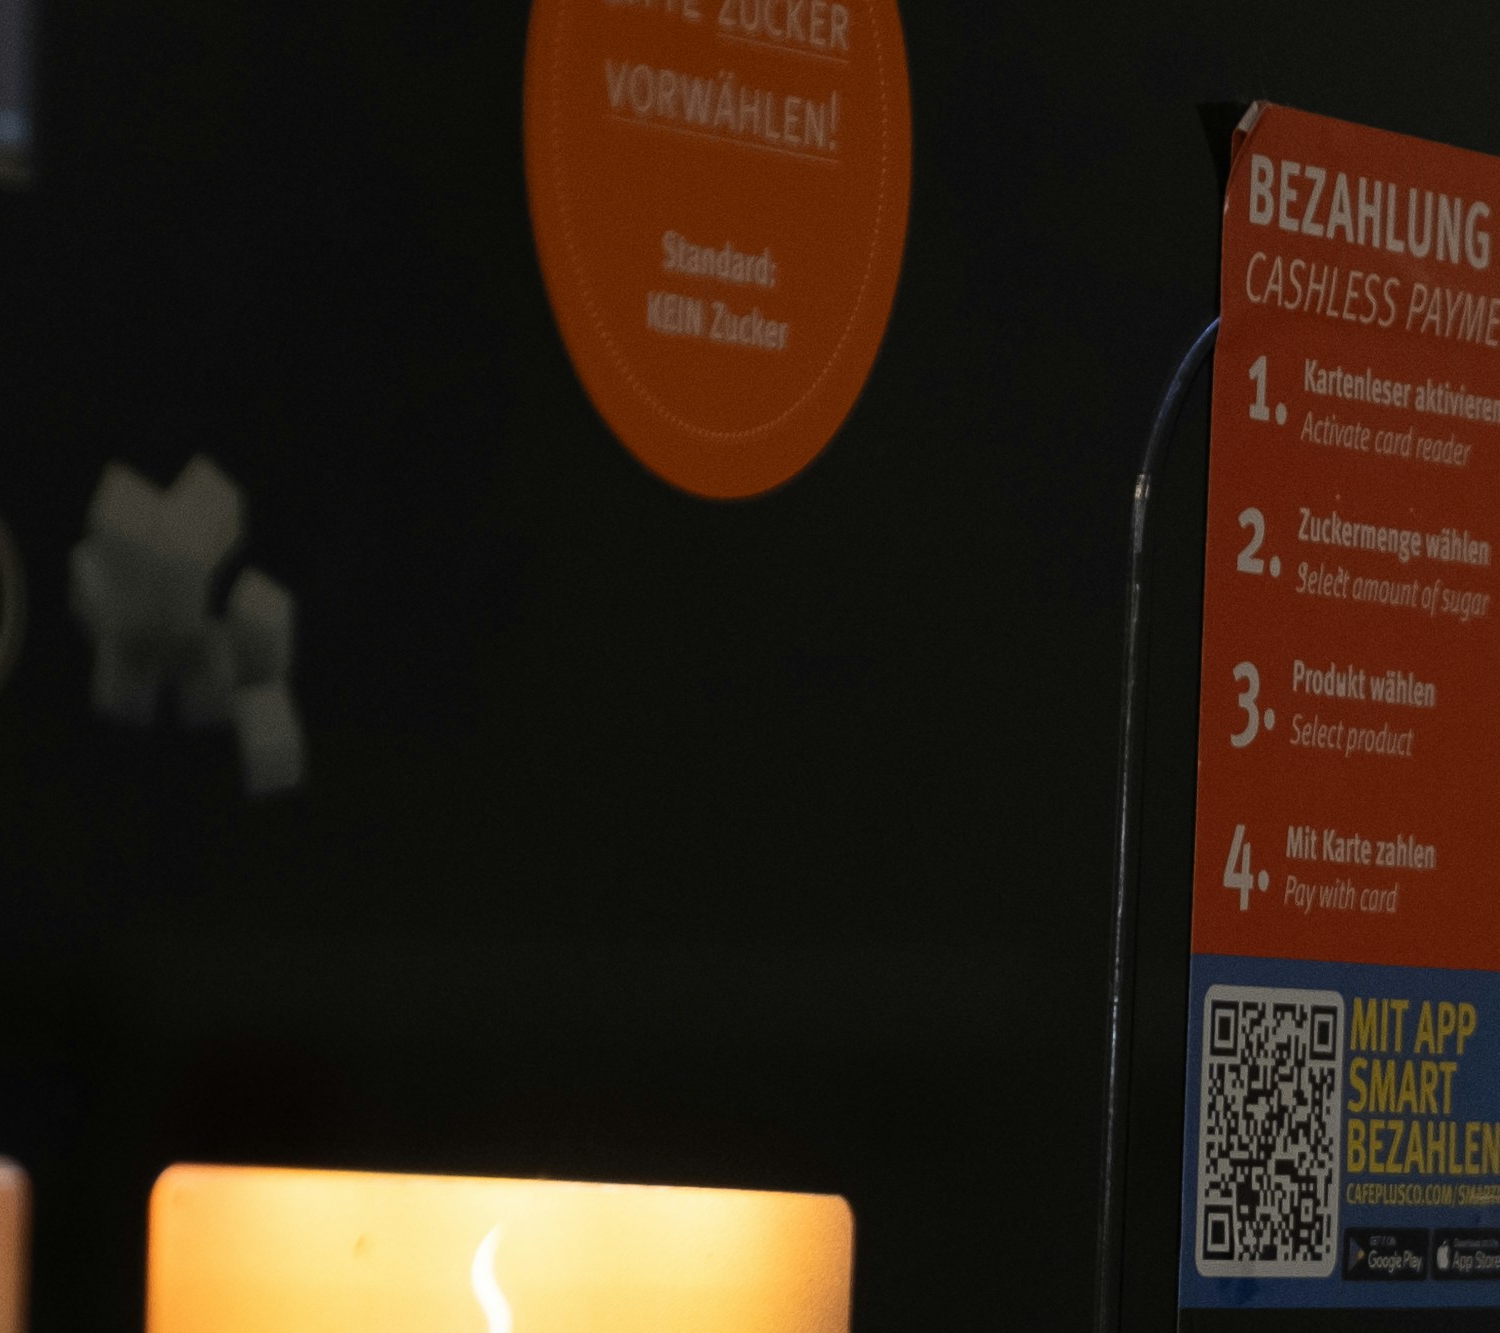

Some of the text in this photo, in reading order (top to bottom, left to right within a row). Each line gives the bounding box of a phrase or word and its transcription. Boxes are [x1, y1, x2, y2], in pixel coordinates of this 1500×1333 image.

[718, 0, 849, 50] ZUCKER
[604, 58, 841, 150] VORWÄHLEN!
[1249, 153, 1491, 270] BEZAHLUNG
[661, 230, 777, 287] Standard:
[1246, 252, 1396, 328] CASHLESS
[646, 290, 789, 351] KEIN Zucker
[1248, 355, 1288, 425] 1.
[1303, 358, 1411, 410] Kartenleser
[1301, 411, 1471, 467] Activate card reader
[1236, 507, 1281, 578] 2.
[1298, 507, 1491, 566] Zuckermenge wählen
[1296, 563, 1490, 622] Select amount of sugar
[1230, 661, 1275, 748] 3.
[1293, 660, 1436, 708] Produkt wählen
[1290, 714, 1413, 757] Select product
[1223, 824, 1270, 910] 4.
[1286, 826, 1437, 870] Mit Karte zahlen
[1284, 876, 1398, 914] Pay with card
[1350, 996, 1477, 1055] MIT APP
[1347, 1057, 1457, 1114] SMART
[1367, 1250, 1423, 1273] Google Play
[1452, 1251, 1473, 1272] App
